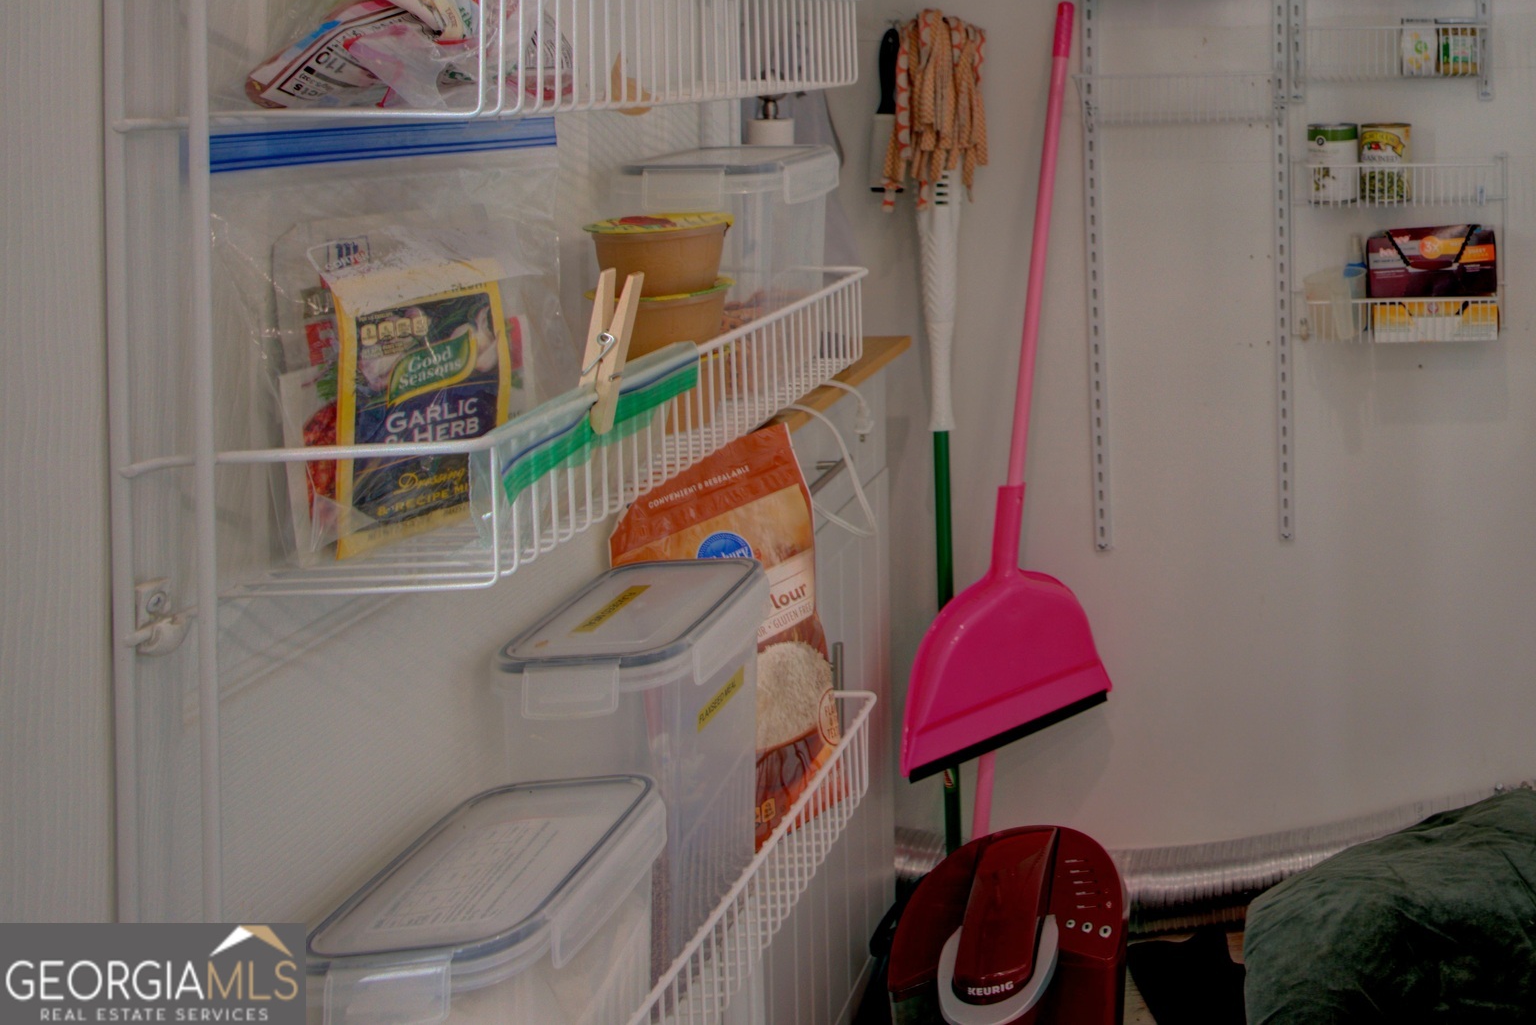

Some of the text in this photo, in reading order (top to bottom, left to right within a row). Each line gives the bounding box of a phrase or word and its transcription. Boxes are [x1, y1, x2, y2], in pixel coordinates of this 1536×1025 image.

[314, 49, 346, 75] 110
[408, 345, 453, 372] Good
[399, 359, 463, 389] Seasons
[386, 397, 479, 434] GARLIC
[413, 416, 480, 445] HERB
[393, 468, 466, 495] Dressing
[648, 485, 697, 509] CONVENIENT
[703, 464, 751, 489] RESEALABLE
[390, 489, 451, 512] RECIPE
[769, 583, 808, 609] lour
[772, 601, 814, 630] GLUTEN FREE
[967, 980, 1015, 996] KEURIG
